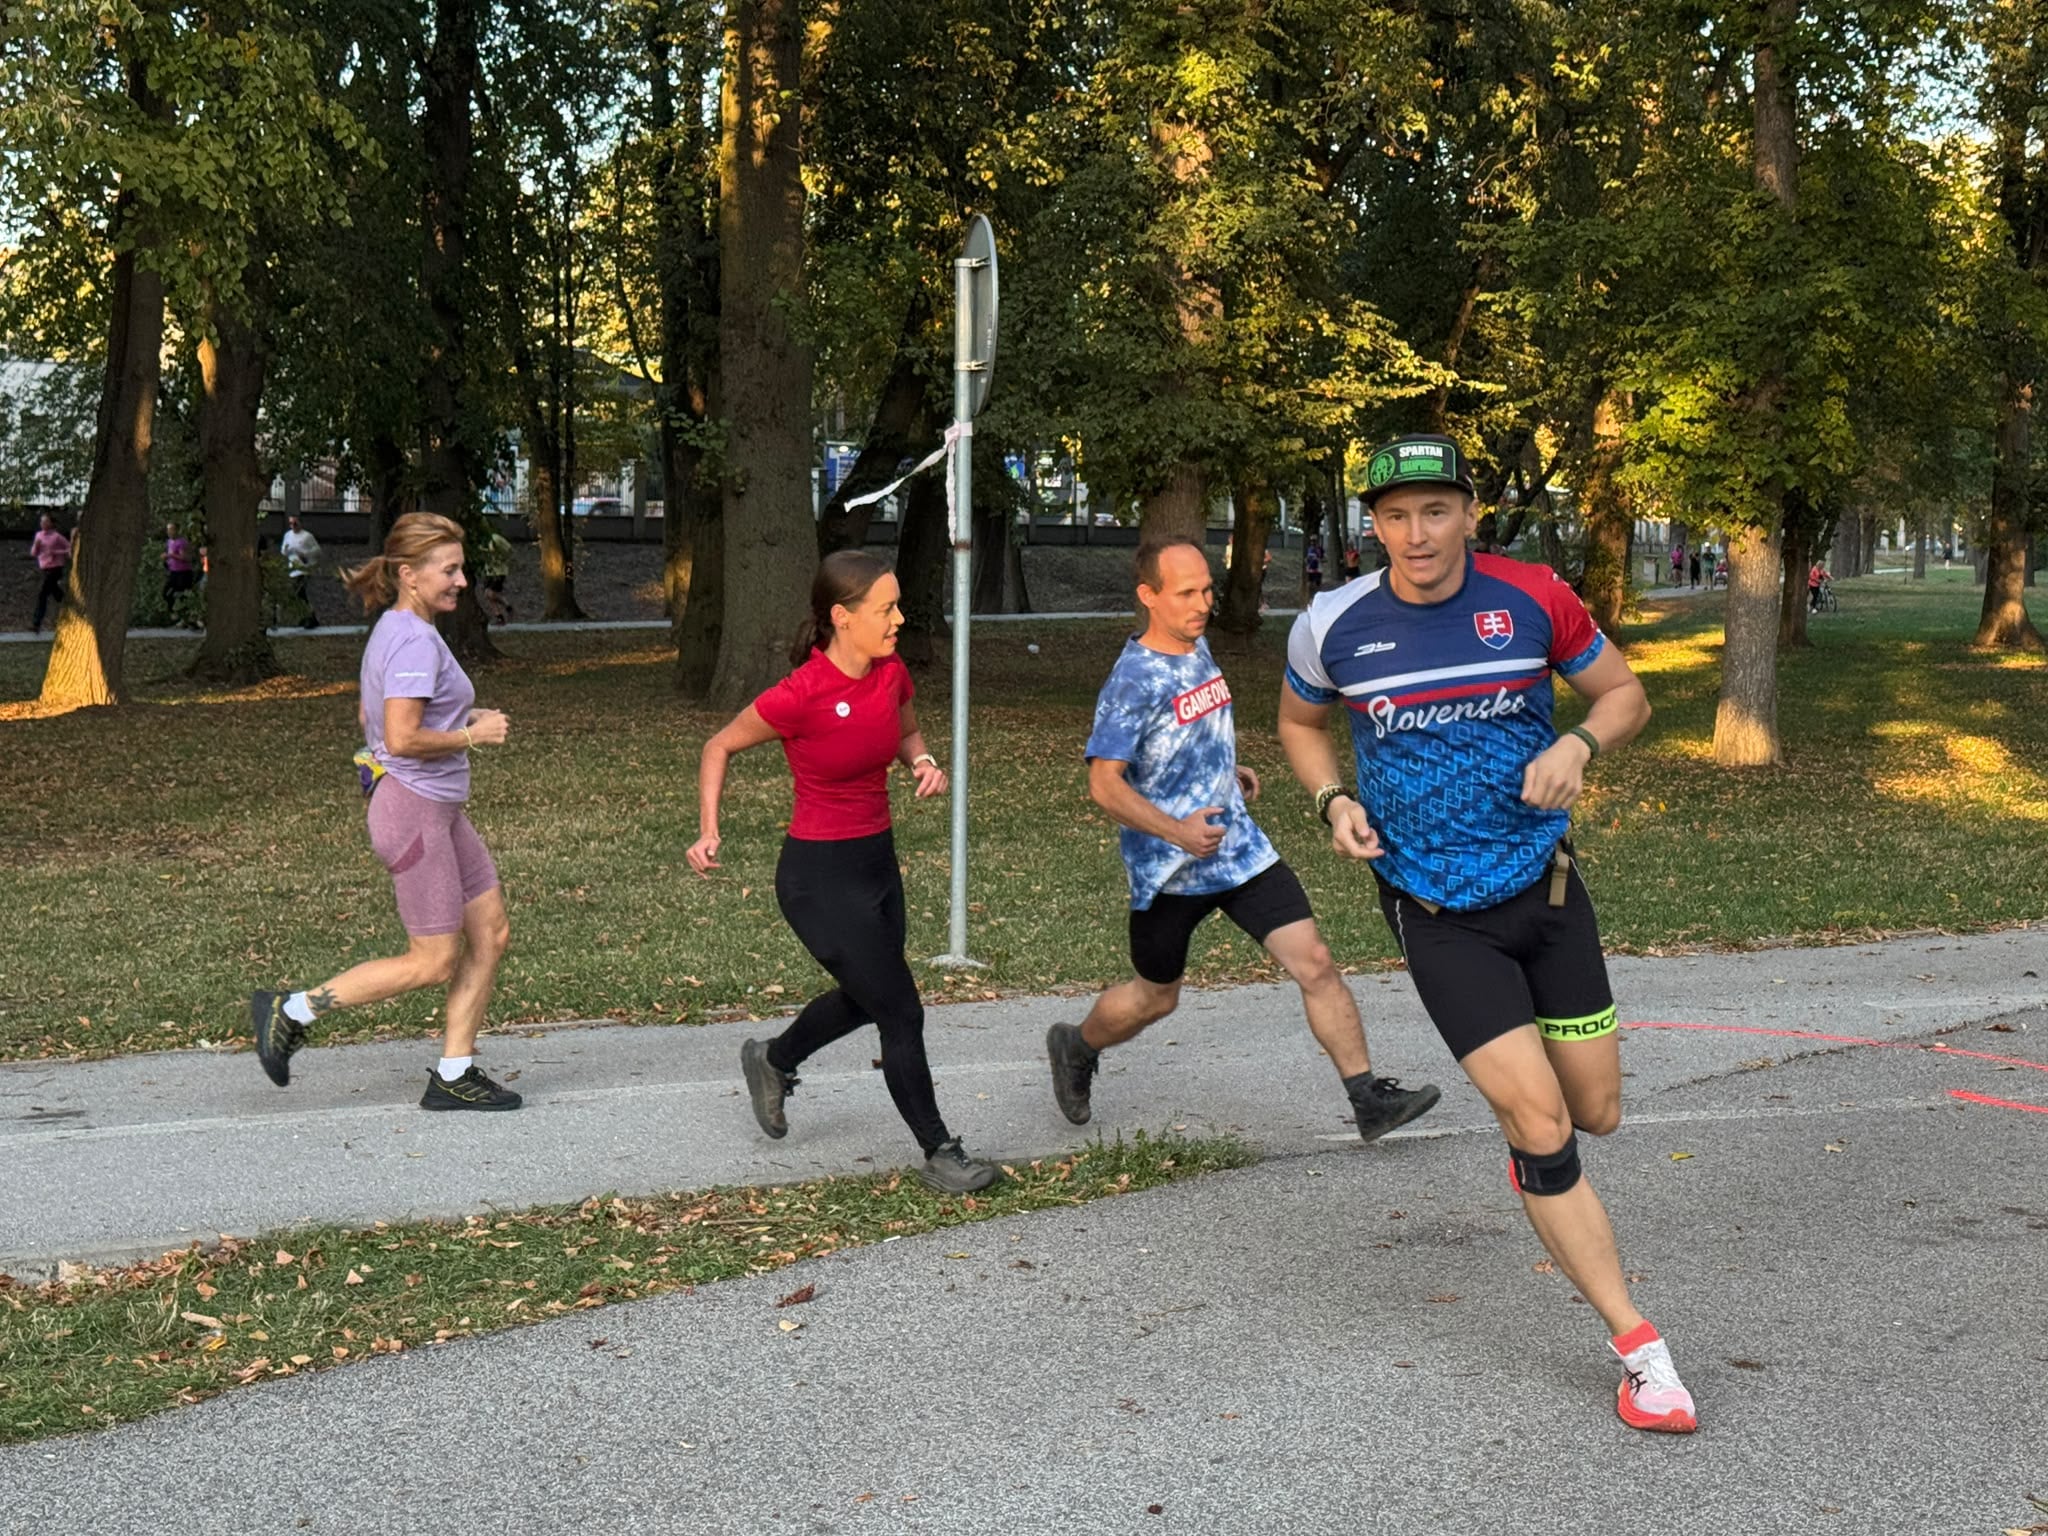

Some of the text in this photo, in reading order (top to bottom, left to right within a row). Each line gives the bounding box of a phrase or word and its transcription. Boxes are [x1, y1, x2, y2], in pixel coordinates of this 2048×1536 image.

[1399, 445, 1443, 458] SPARTAN
[1179, 686, 1214, 720] GAME
[1368, 686, 1526, 739] Slovensko
